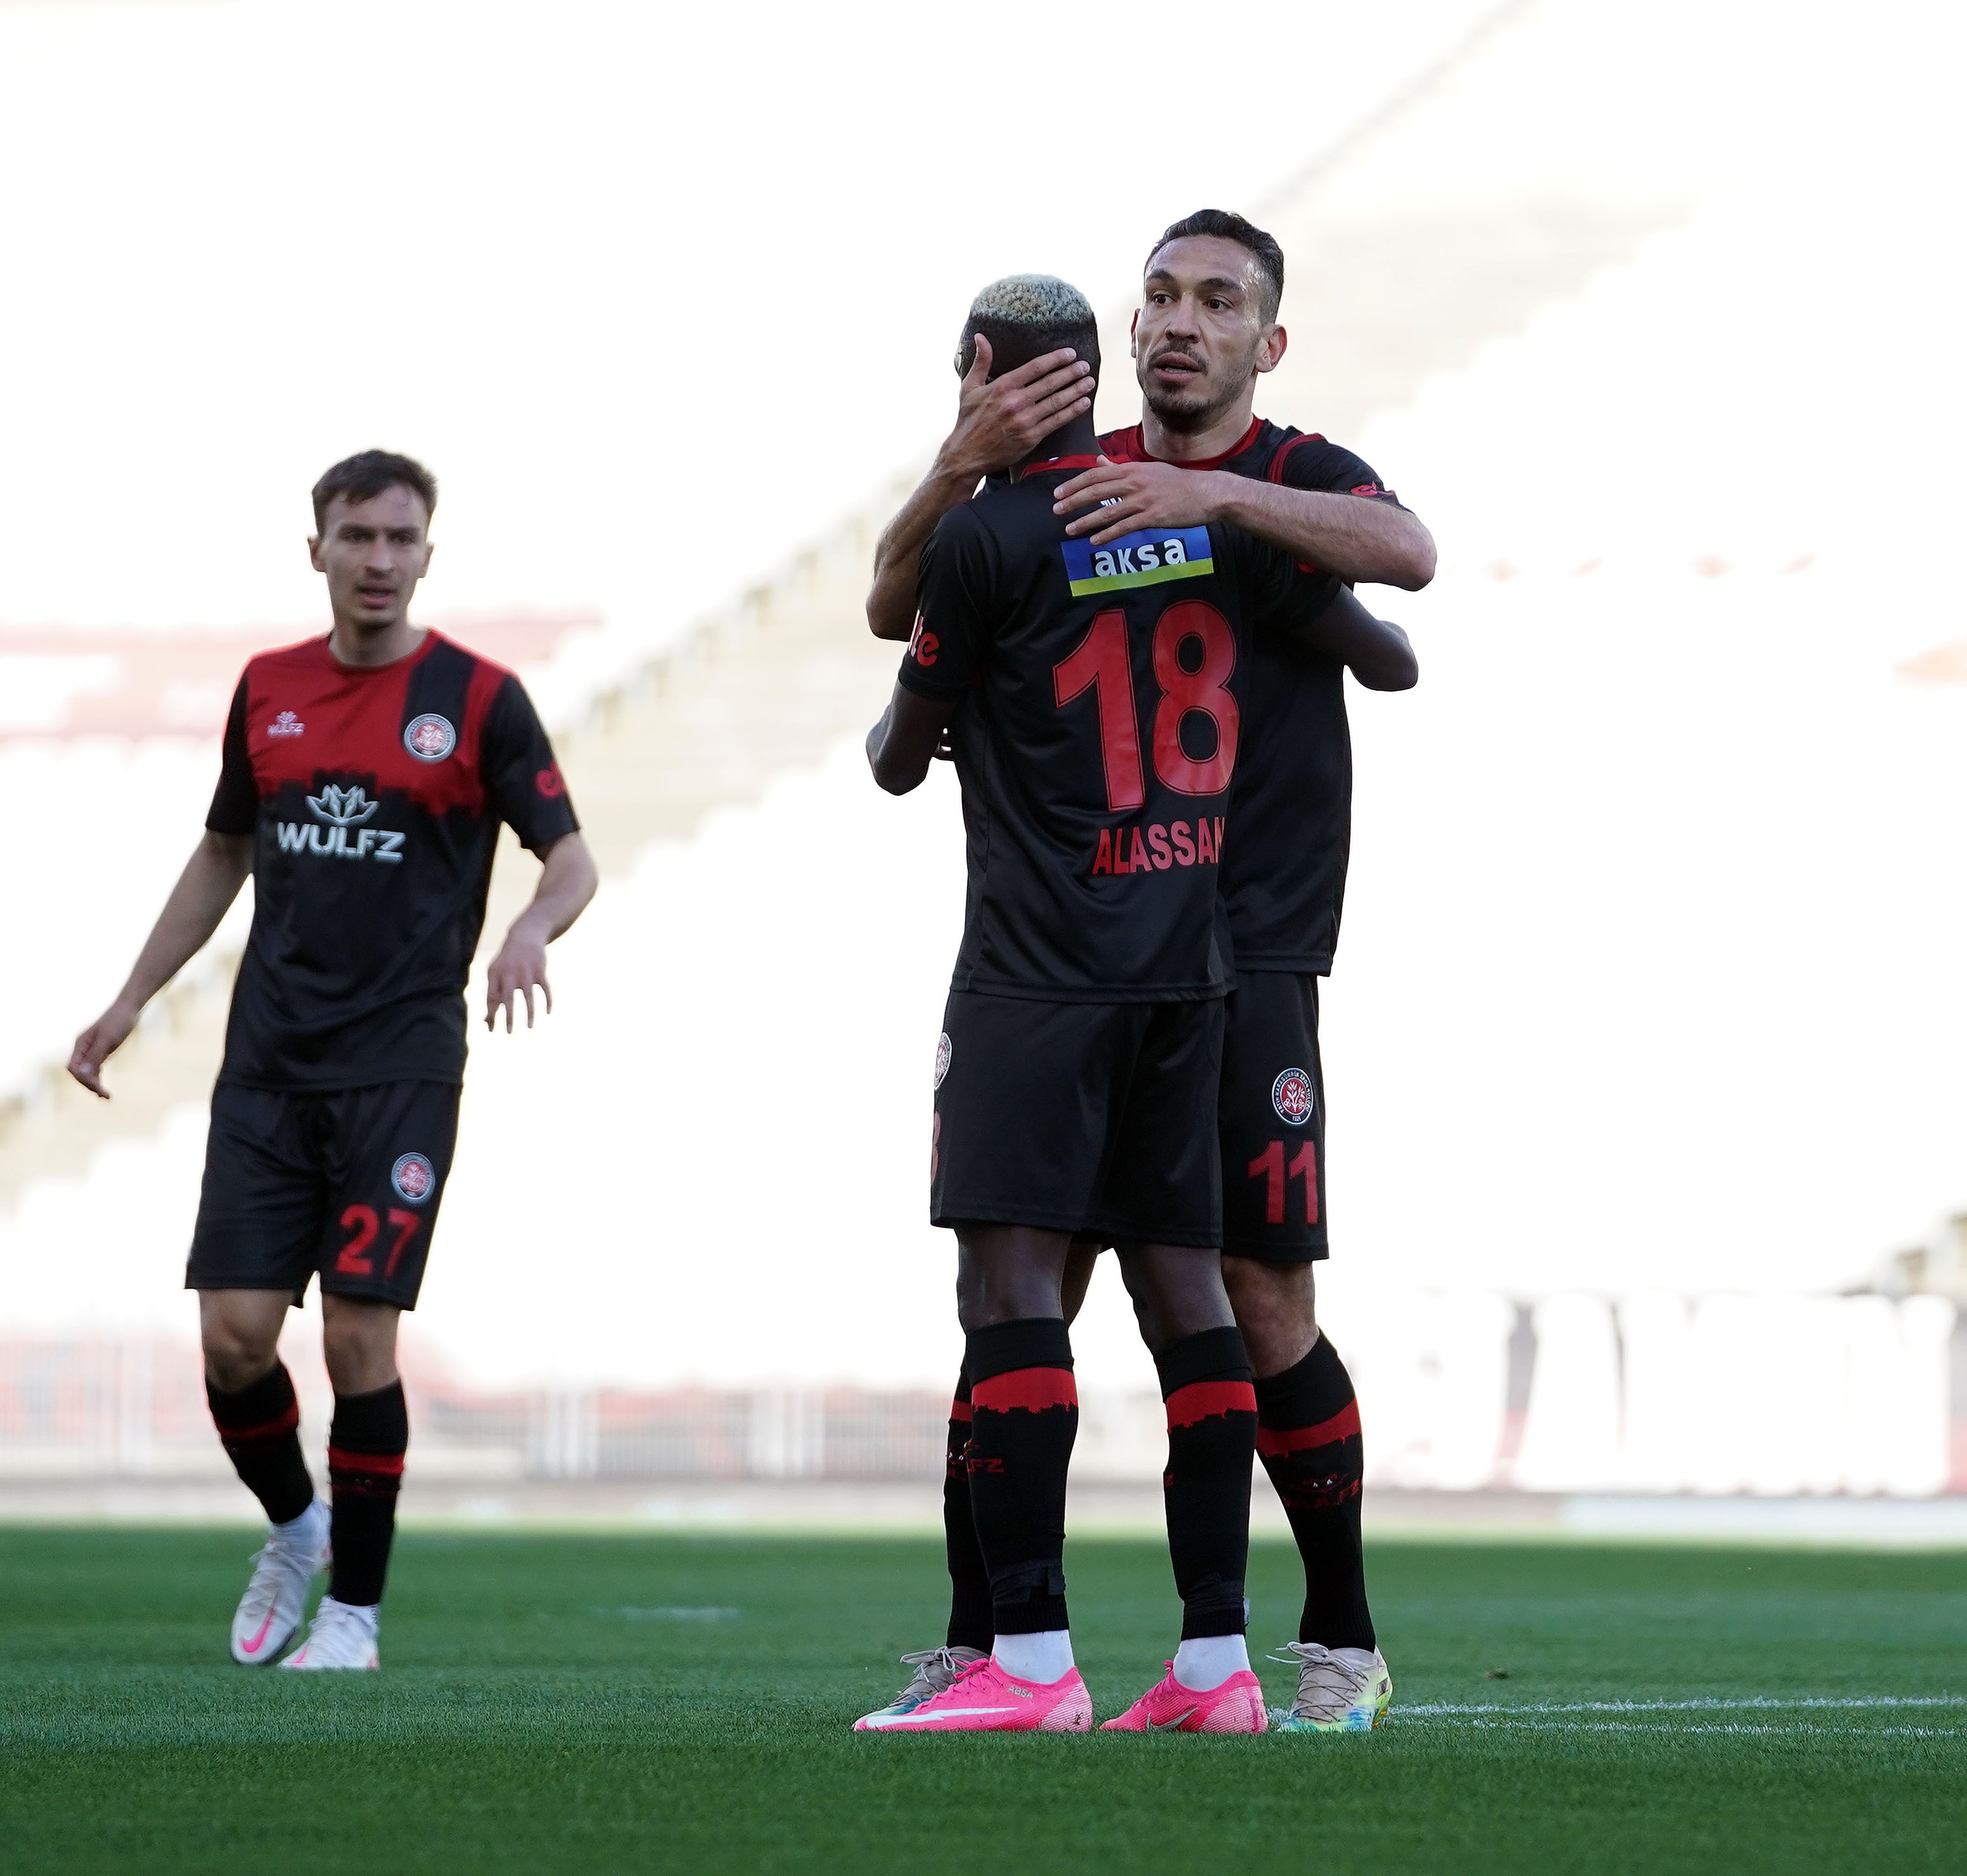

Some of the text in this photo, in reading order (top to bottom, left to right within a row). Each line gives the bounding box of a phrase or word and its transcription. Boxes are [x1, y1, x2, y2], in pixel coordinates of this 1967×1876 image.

[1095, 538, 1186, 577] aksa
[1053, 599, 1240, 811] 18
[276, 823, 407, 862] WULFZ
[1248, 1140, 1318, 1224] 11
[336, 1205, 420, 1278] 27
